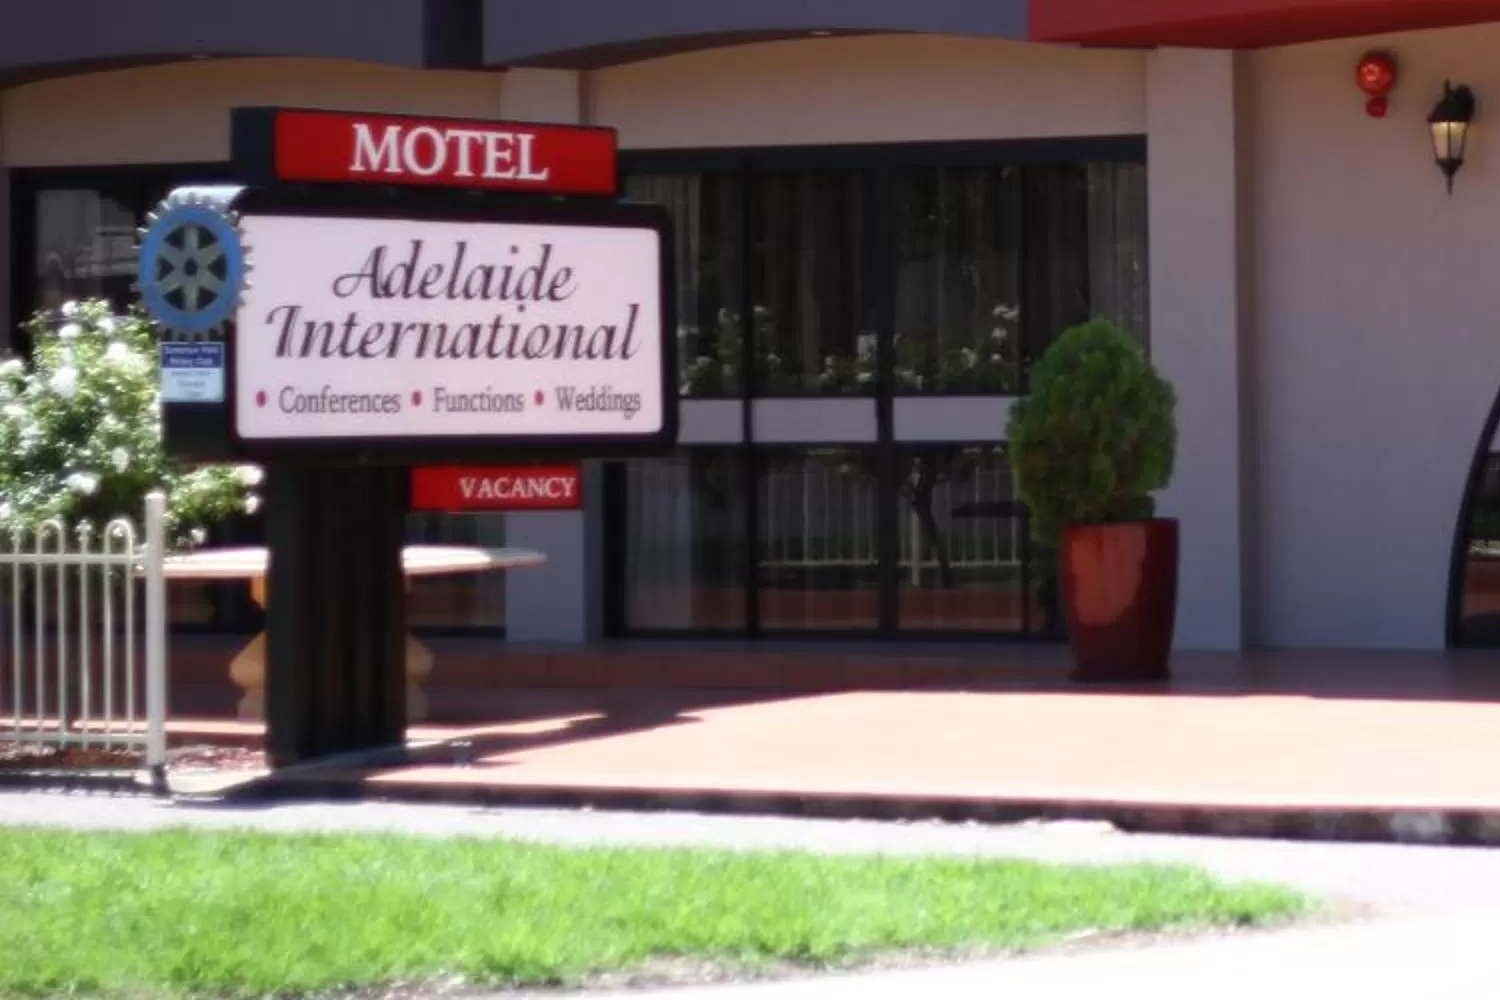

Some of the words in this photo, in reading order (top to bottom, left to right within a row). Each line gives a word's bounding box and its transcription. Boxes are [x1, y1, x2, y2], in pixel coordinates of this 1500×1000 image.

[349, 123, 549, 181] MOTEL
[333, 239, 578, 301] Adelaide
[265, 303, 641, 361] International
[278, 385, 401, 414] Conferences
[432, 386, 525, 413] Functions
[555, 386, 642, 420] Weddings
[459, 477, 577, 499] VACANCY
